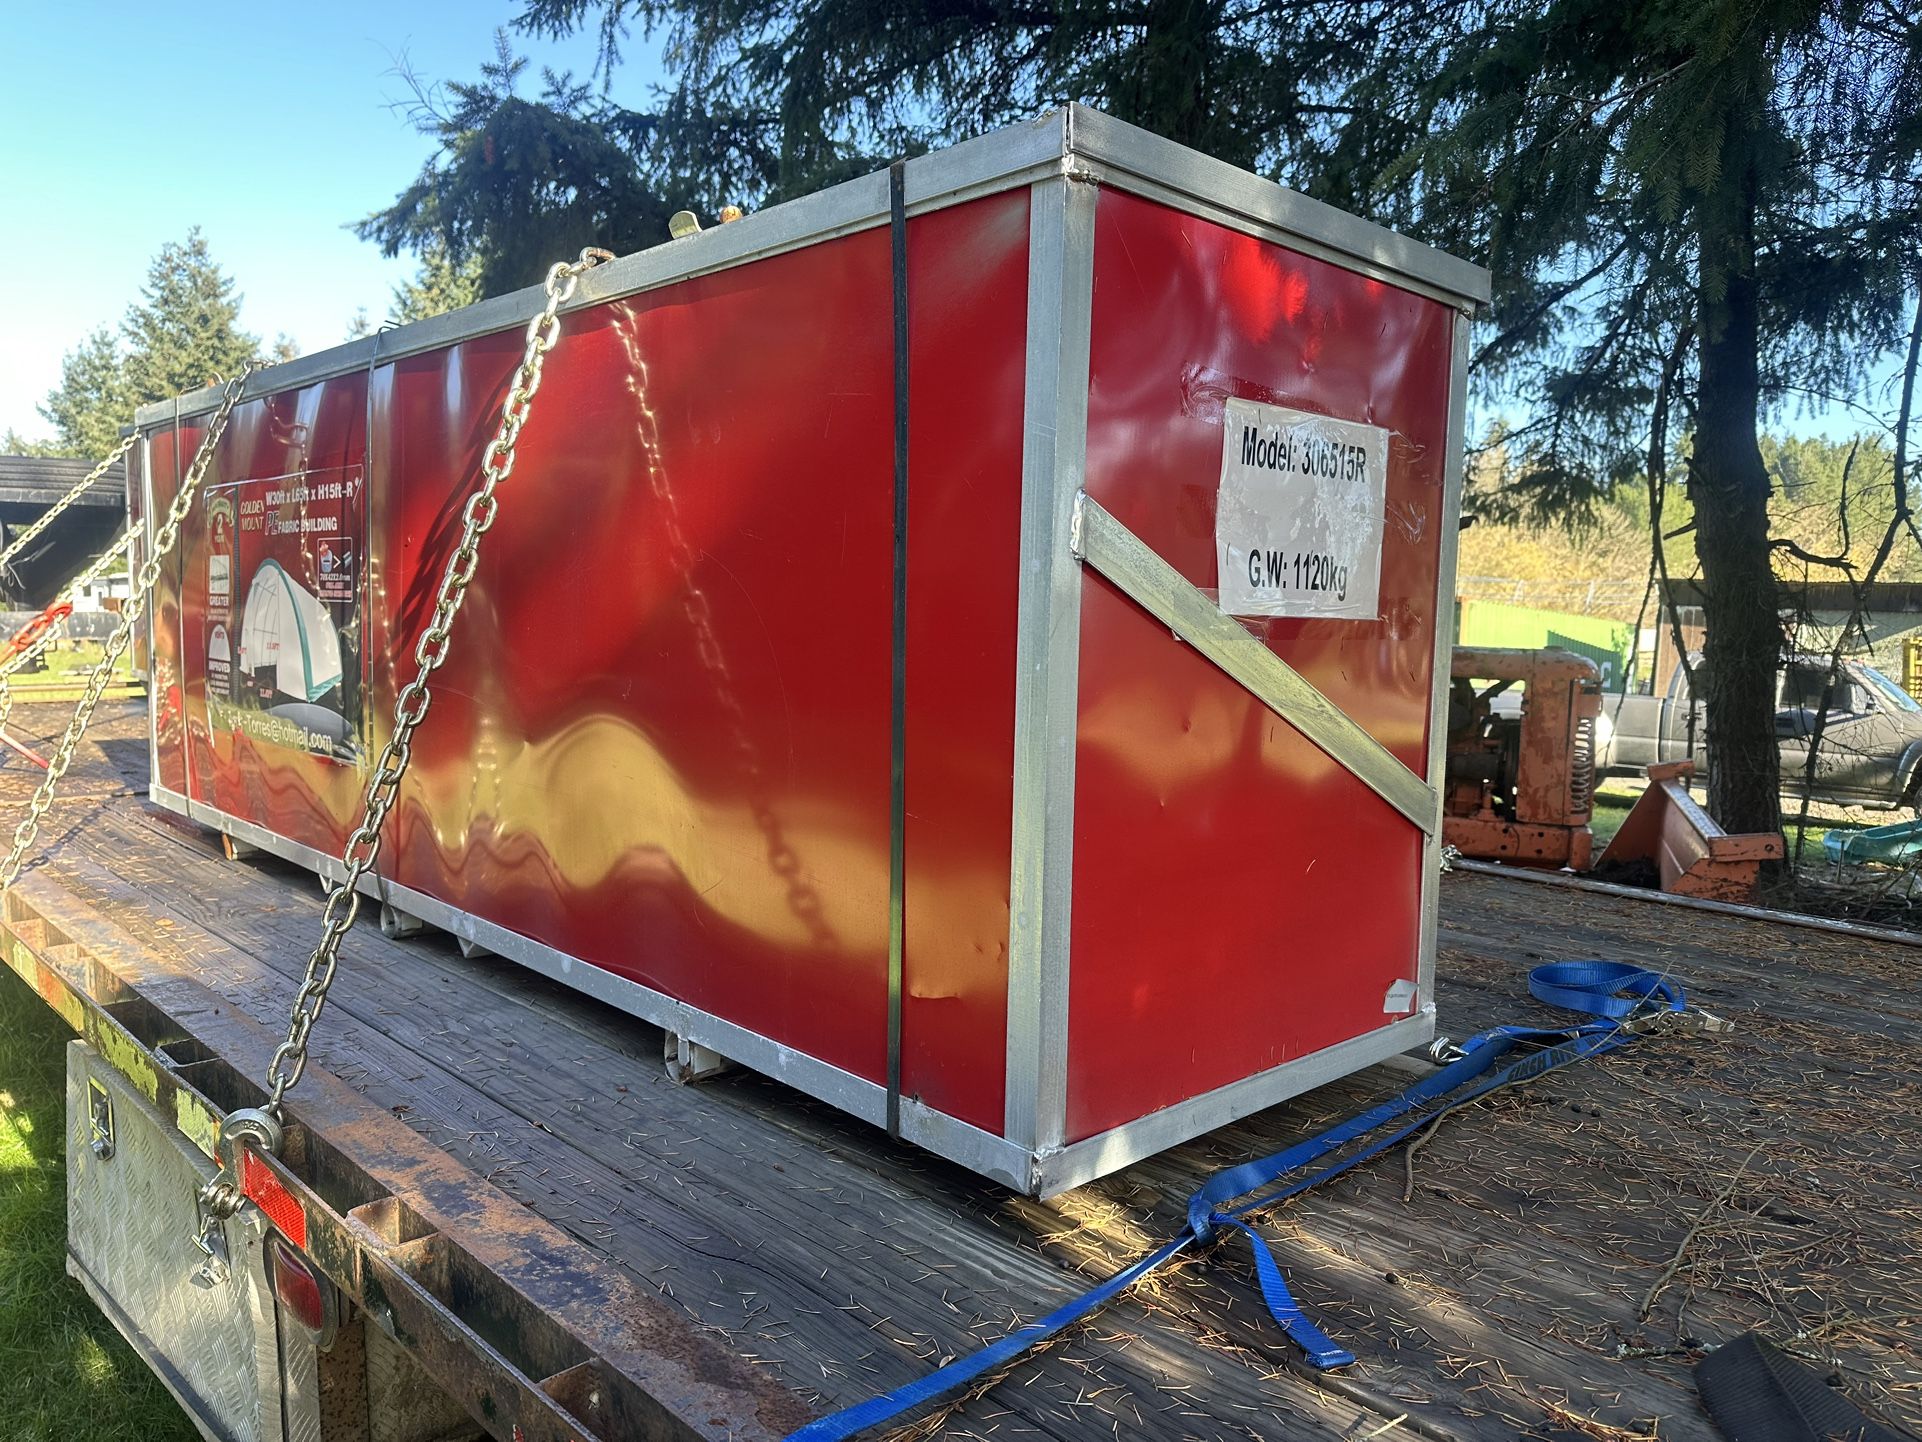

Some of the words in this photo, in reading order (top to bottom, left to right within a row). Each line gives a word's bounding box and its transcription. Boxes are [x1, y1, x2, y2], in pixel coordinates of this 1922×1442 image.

[1241, 426, 1298, 472] Model:
[1301, 438, 1367, 483] 306515R
[265, 489, 285, 506] W30ft
[286, 492, 291, 503] x
[311, 488, 317, 501] x
[240, 499, 265, 515] GOLDEN
[216, 513, 223, 535] 2
[241, 516, 264, 531] MOUNT
[278, 519, 300, 534] FABRIC
[301, 516, 338, 533] BUILDING
[1248, 549, 1287, 589] G.W:
[1293, 551, 1348, 602] 1120kg
